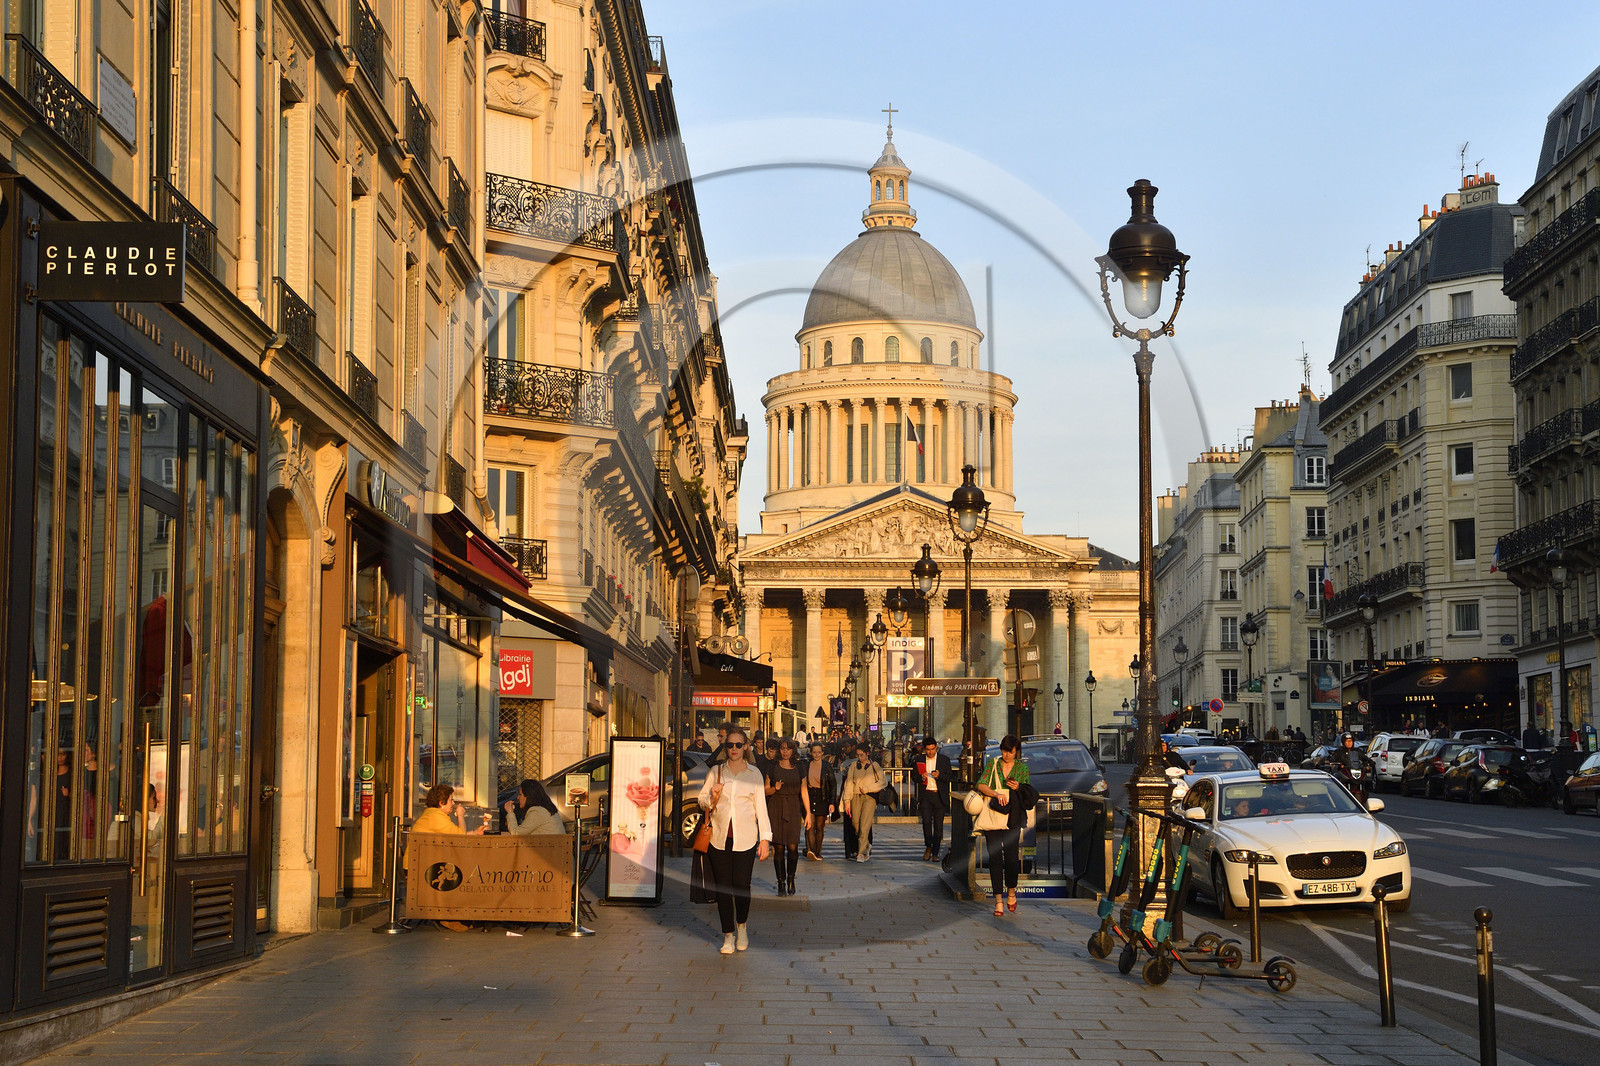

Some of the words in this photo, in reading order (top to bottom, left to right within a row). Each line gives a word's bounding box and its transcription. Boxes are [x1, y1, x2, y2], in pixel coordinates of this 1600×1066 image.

[46, 245, 176, 260] CLAUDIE
[46, 262, 176, 276] PIERLOT
[891, 651, 915, 681] P
[499, 663, 531, 691] lgdj
[692, 696, 715, 705] POMME
[723, 697, 738, 705] PAIN
[466, 864, 554, 884] Amorino
[459, 885, 495, 893] GELATO
[1014, 886, 1045, 894] PANTHÉON
